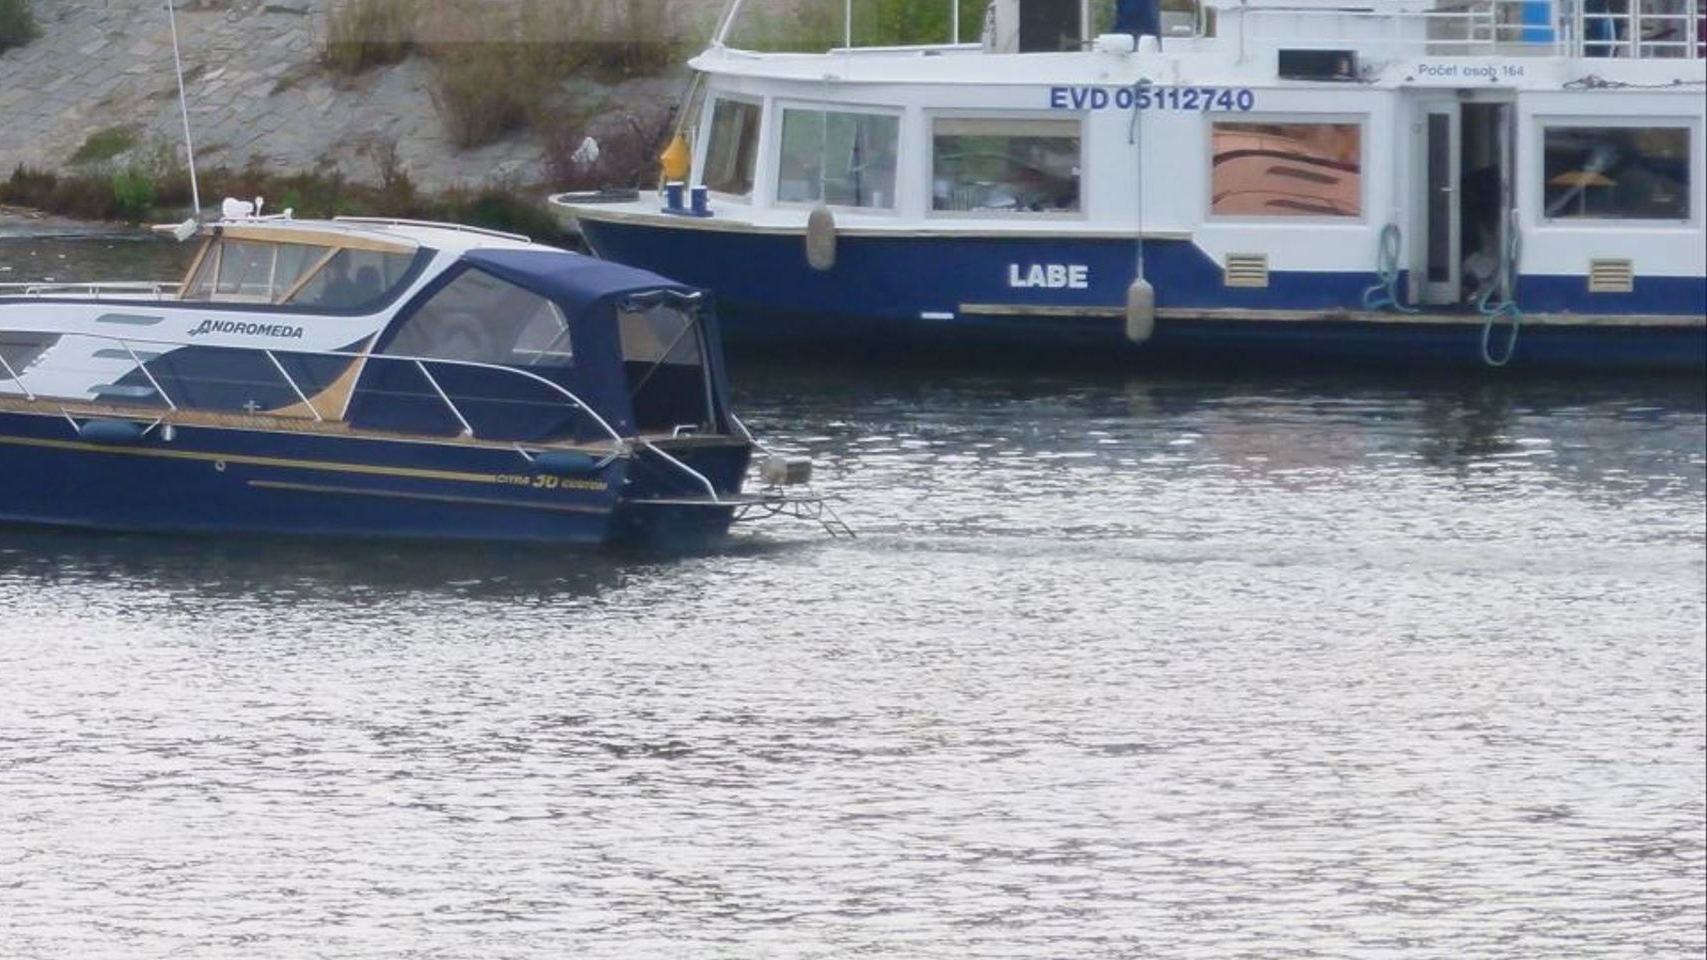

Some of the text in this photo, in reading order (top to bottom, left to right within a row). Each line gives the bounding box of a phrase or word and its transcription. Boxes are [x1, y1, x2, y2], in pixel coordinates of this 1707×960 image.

[1463, 65, 1497, 77] osob
[1050, 86, 1255, 111] EVD 05112740
[1010, 263, 1088, 288] LABE
[186, 319, 303, 339] ANDROMEDA
